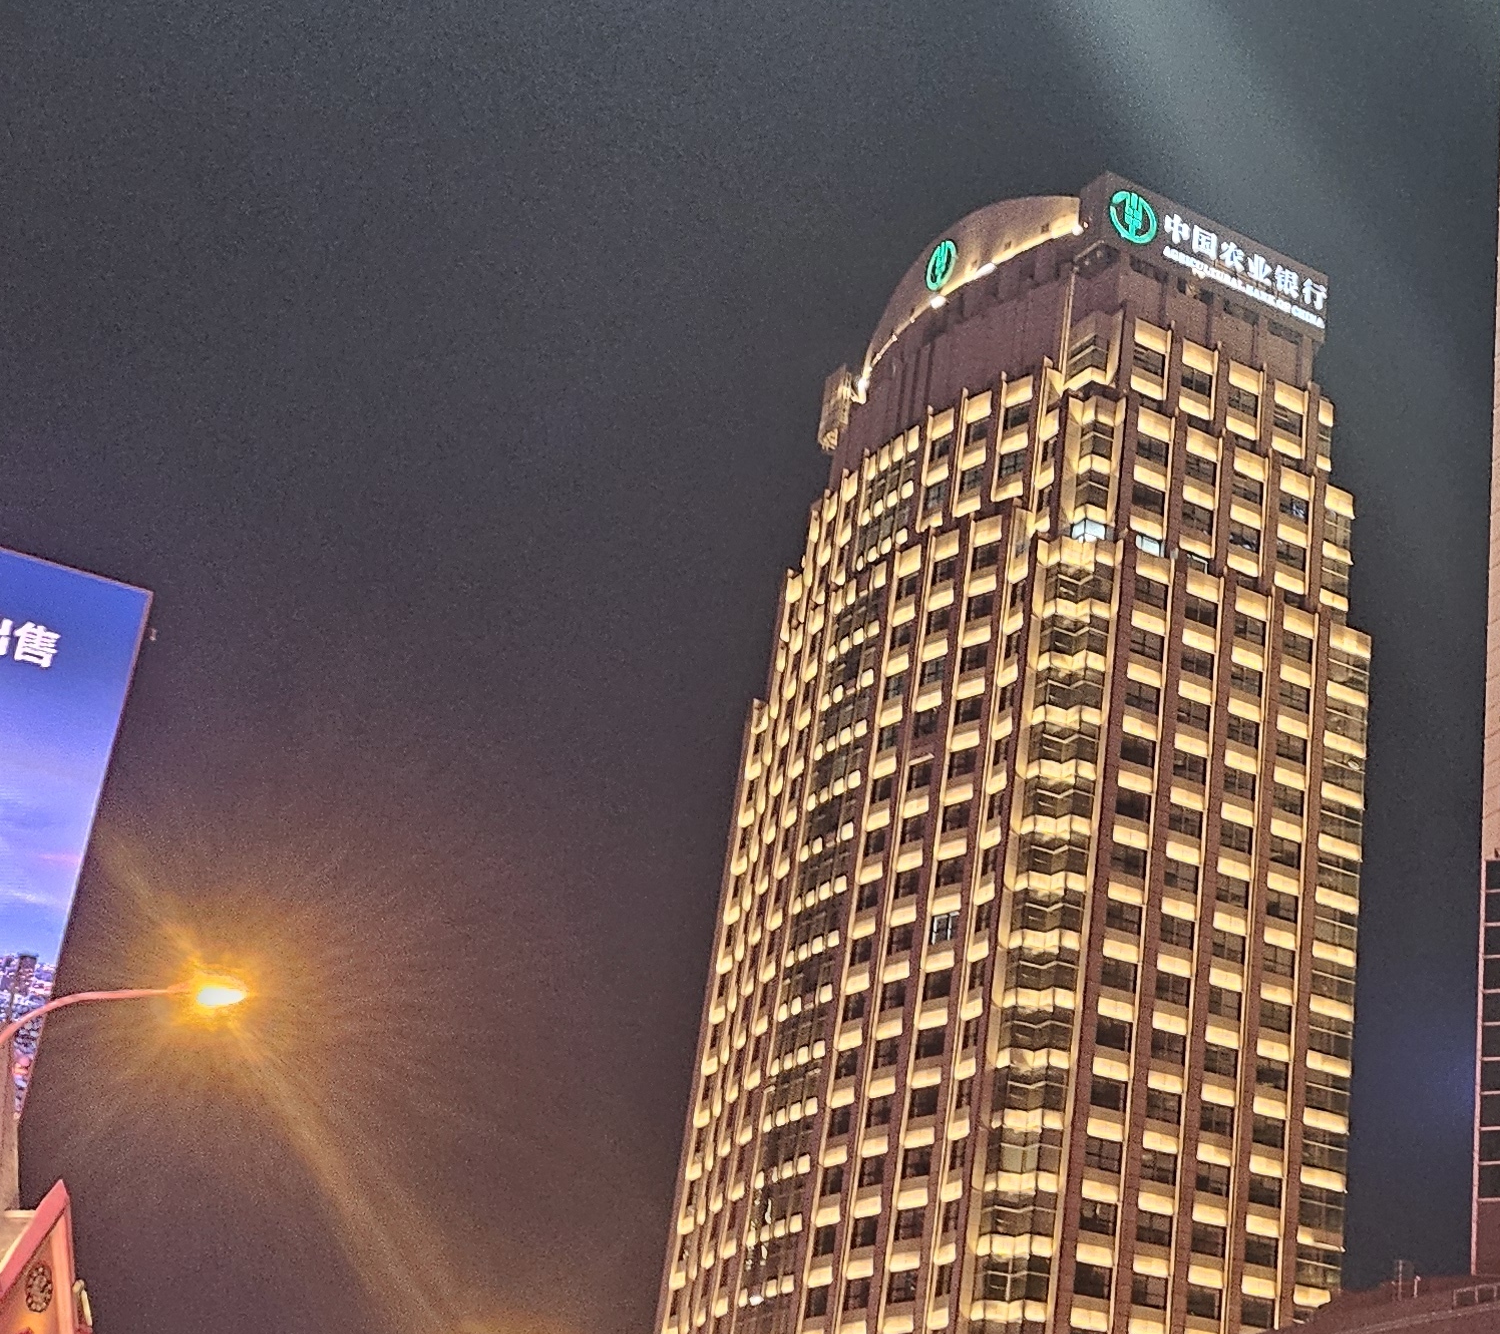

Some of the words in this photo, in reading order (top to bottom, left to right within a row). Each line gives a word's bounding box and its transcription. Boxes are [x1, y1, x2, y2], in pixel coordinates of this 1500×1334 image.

[1163, 213, 1328, 311] 中国农业银行
[0, 617, 61, 668] 售
